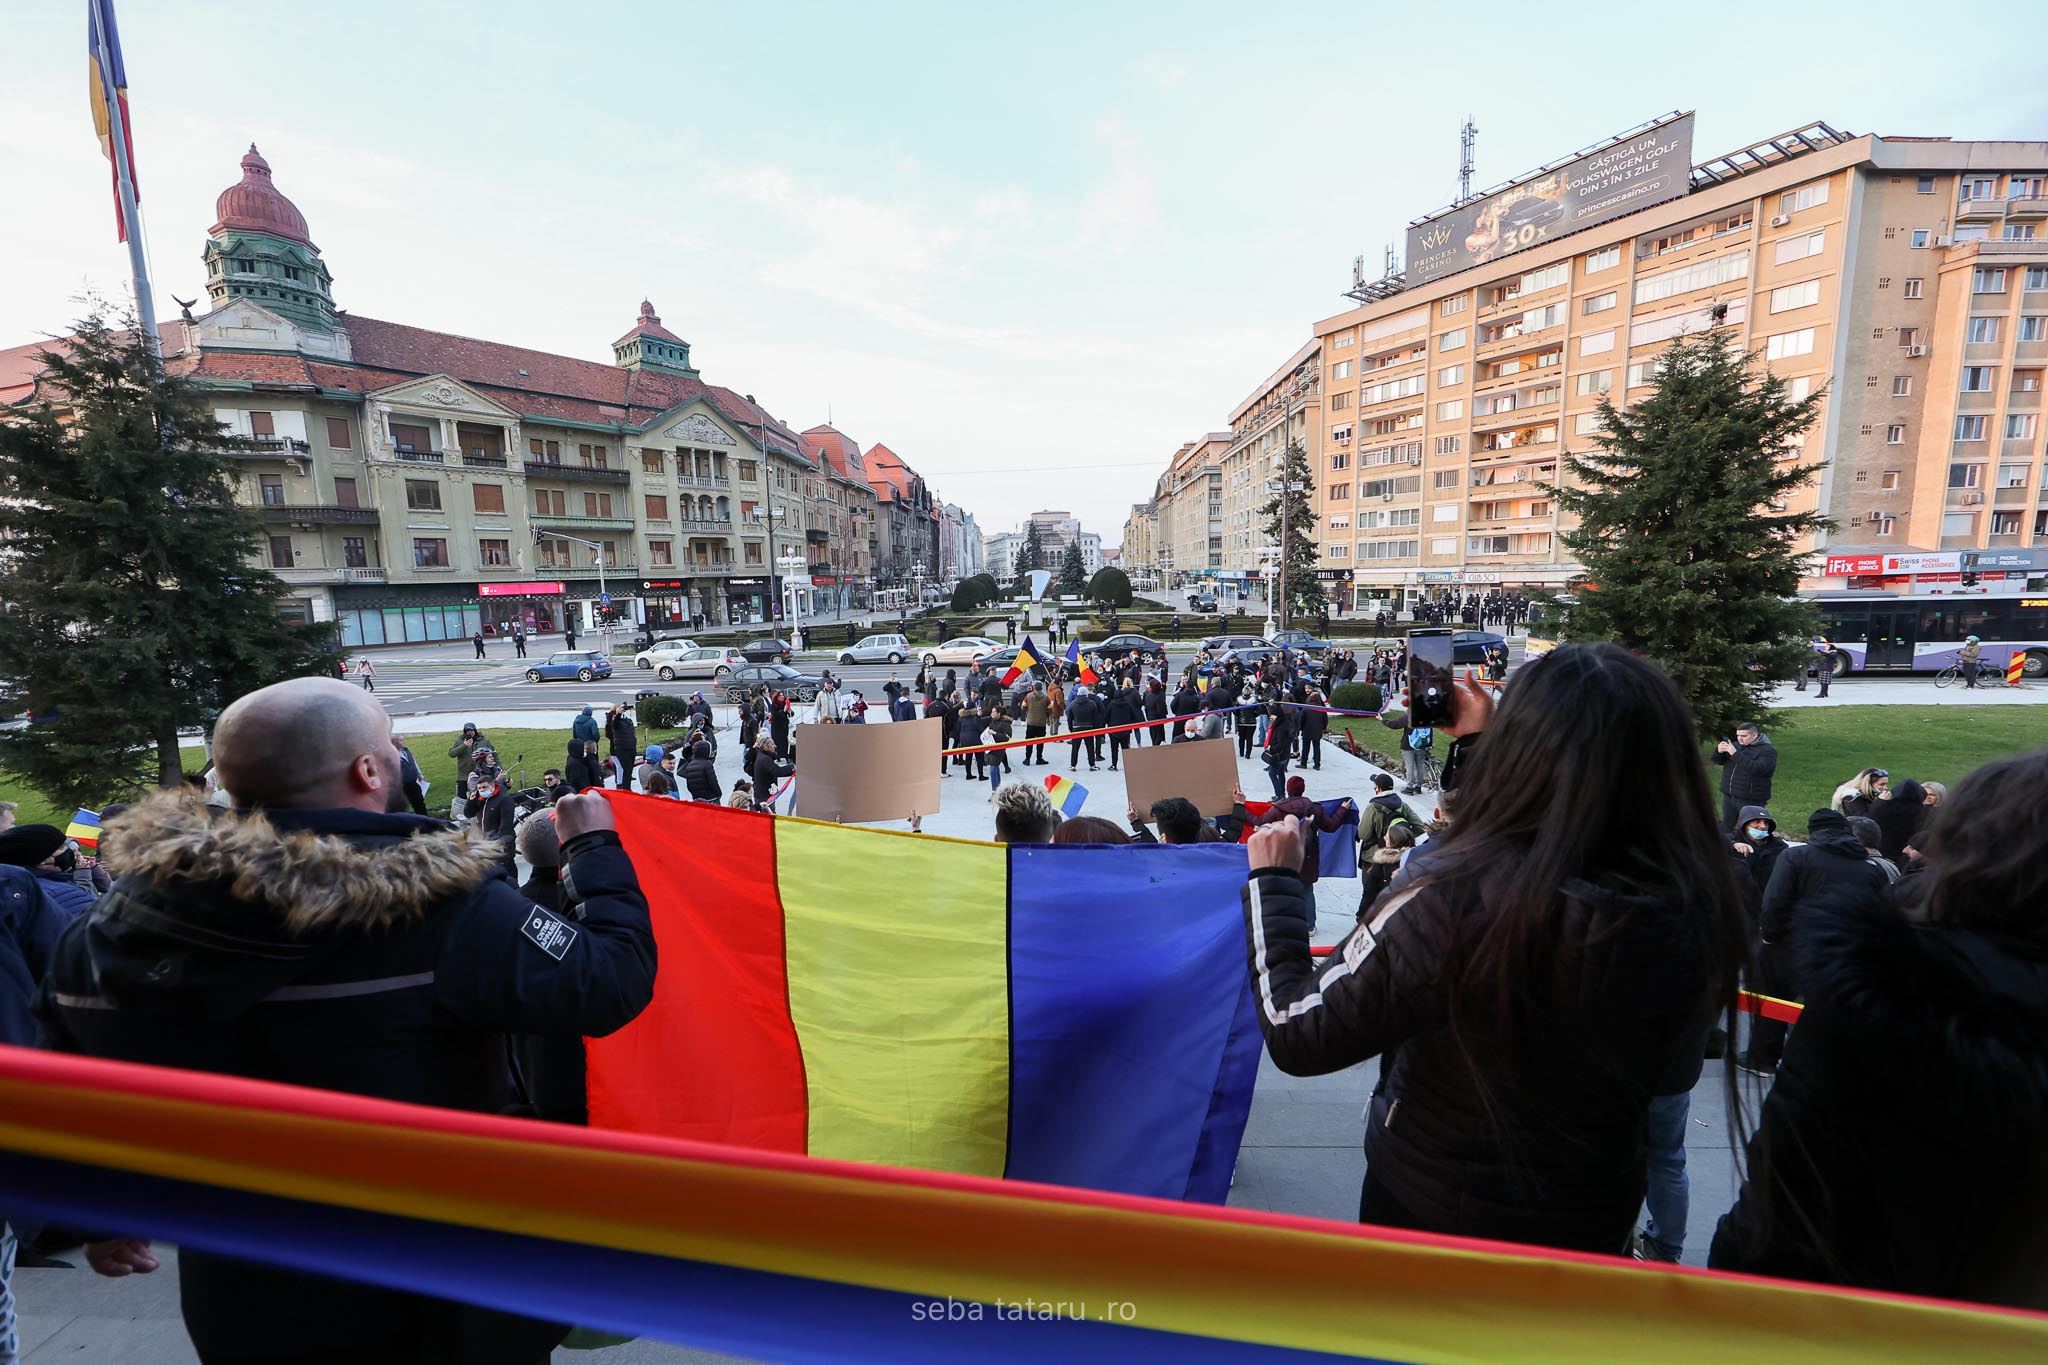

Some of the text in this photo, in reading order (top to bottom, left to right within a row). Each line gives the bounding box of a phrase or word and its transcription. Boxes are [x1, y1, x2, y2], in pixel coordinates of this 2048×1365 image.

[1638, 138, 1657, 151] UN
[1566, 155, 1643, 191] VOLKSWAGEN
[1645, 140, 1679, 160] GOLF
[1579, 159, 1660, 197] DIN 3 ÎN 3 ZILE
[1577, 181, 1661, 217] princesscasino.ro
[1414, 247, 1457, 269] PRINCESS
[1418, 257, 1452, 274] CASINO
[1317, 571, 1335, 579] GRILL
[1828, 559, 1855, 574] iFix
[540, 921, 559, 948] APPAREL
